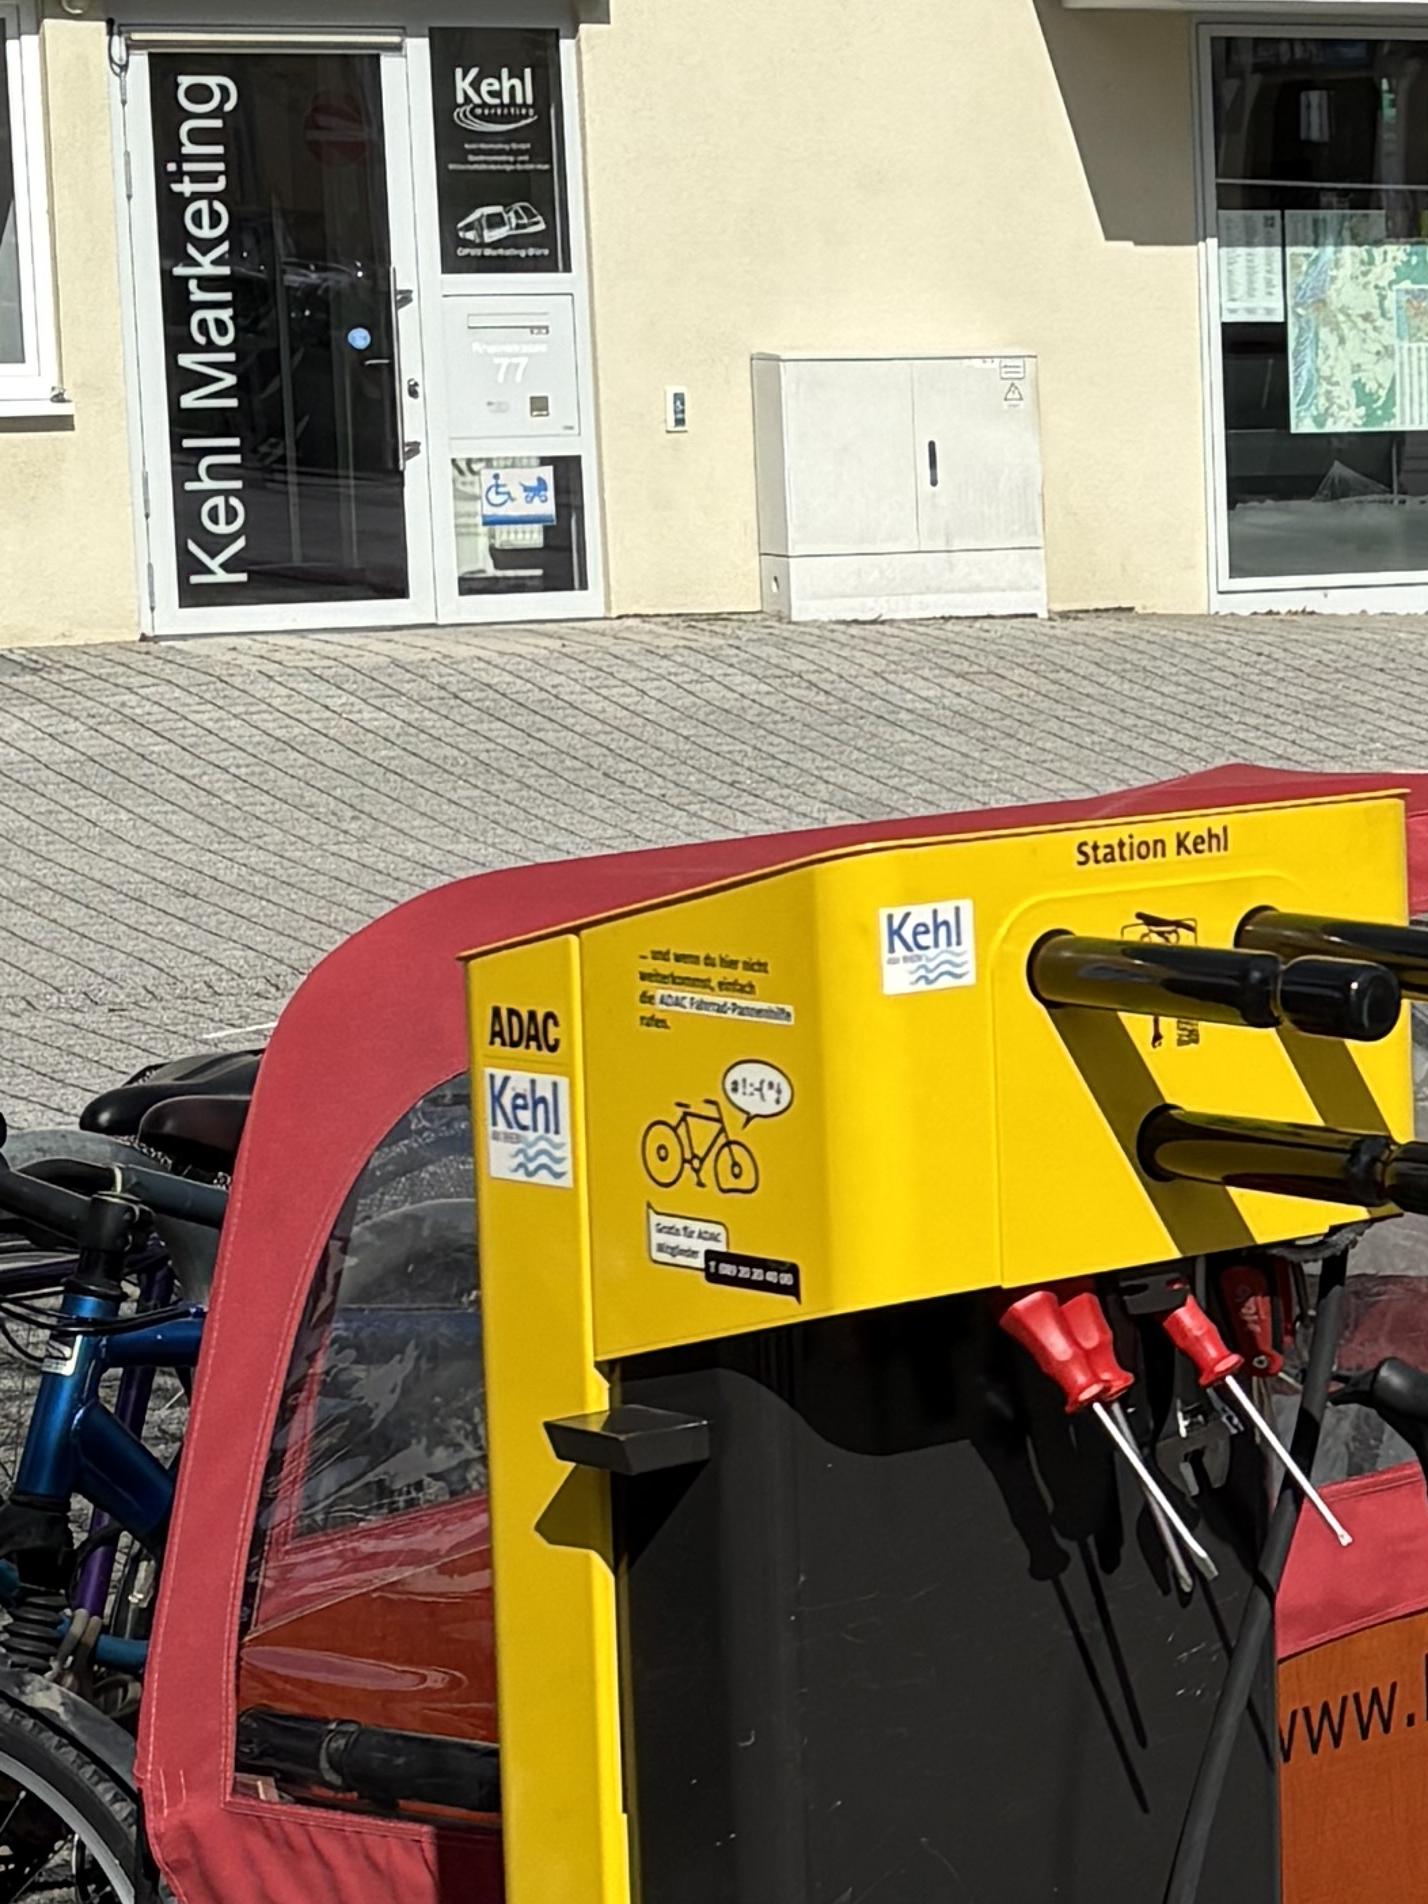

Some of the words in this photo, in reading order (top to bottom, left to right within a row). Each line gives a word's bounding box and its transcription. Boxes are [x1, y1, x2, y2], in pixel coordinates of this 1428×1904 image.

[454, 67, 534, 105] Kehl
[166, 75, 239, 410] Marketing
[493, 356, 529, 383] 77
[182, 435, 248, 584] Kehl
[1076, 832, 1167, 867] Station
[1175, 824, 1229, 857] Kehl
[886, 905, 962, 954] Kehl
[488, 1005, 561, 1054] ADAC
[488, 1073, 561, 1135] Kehl
